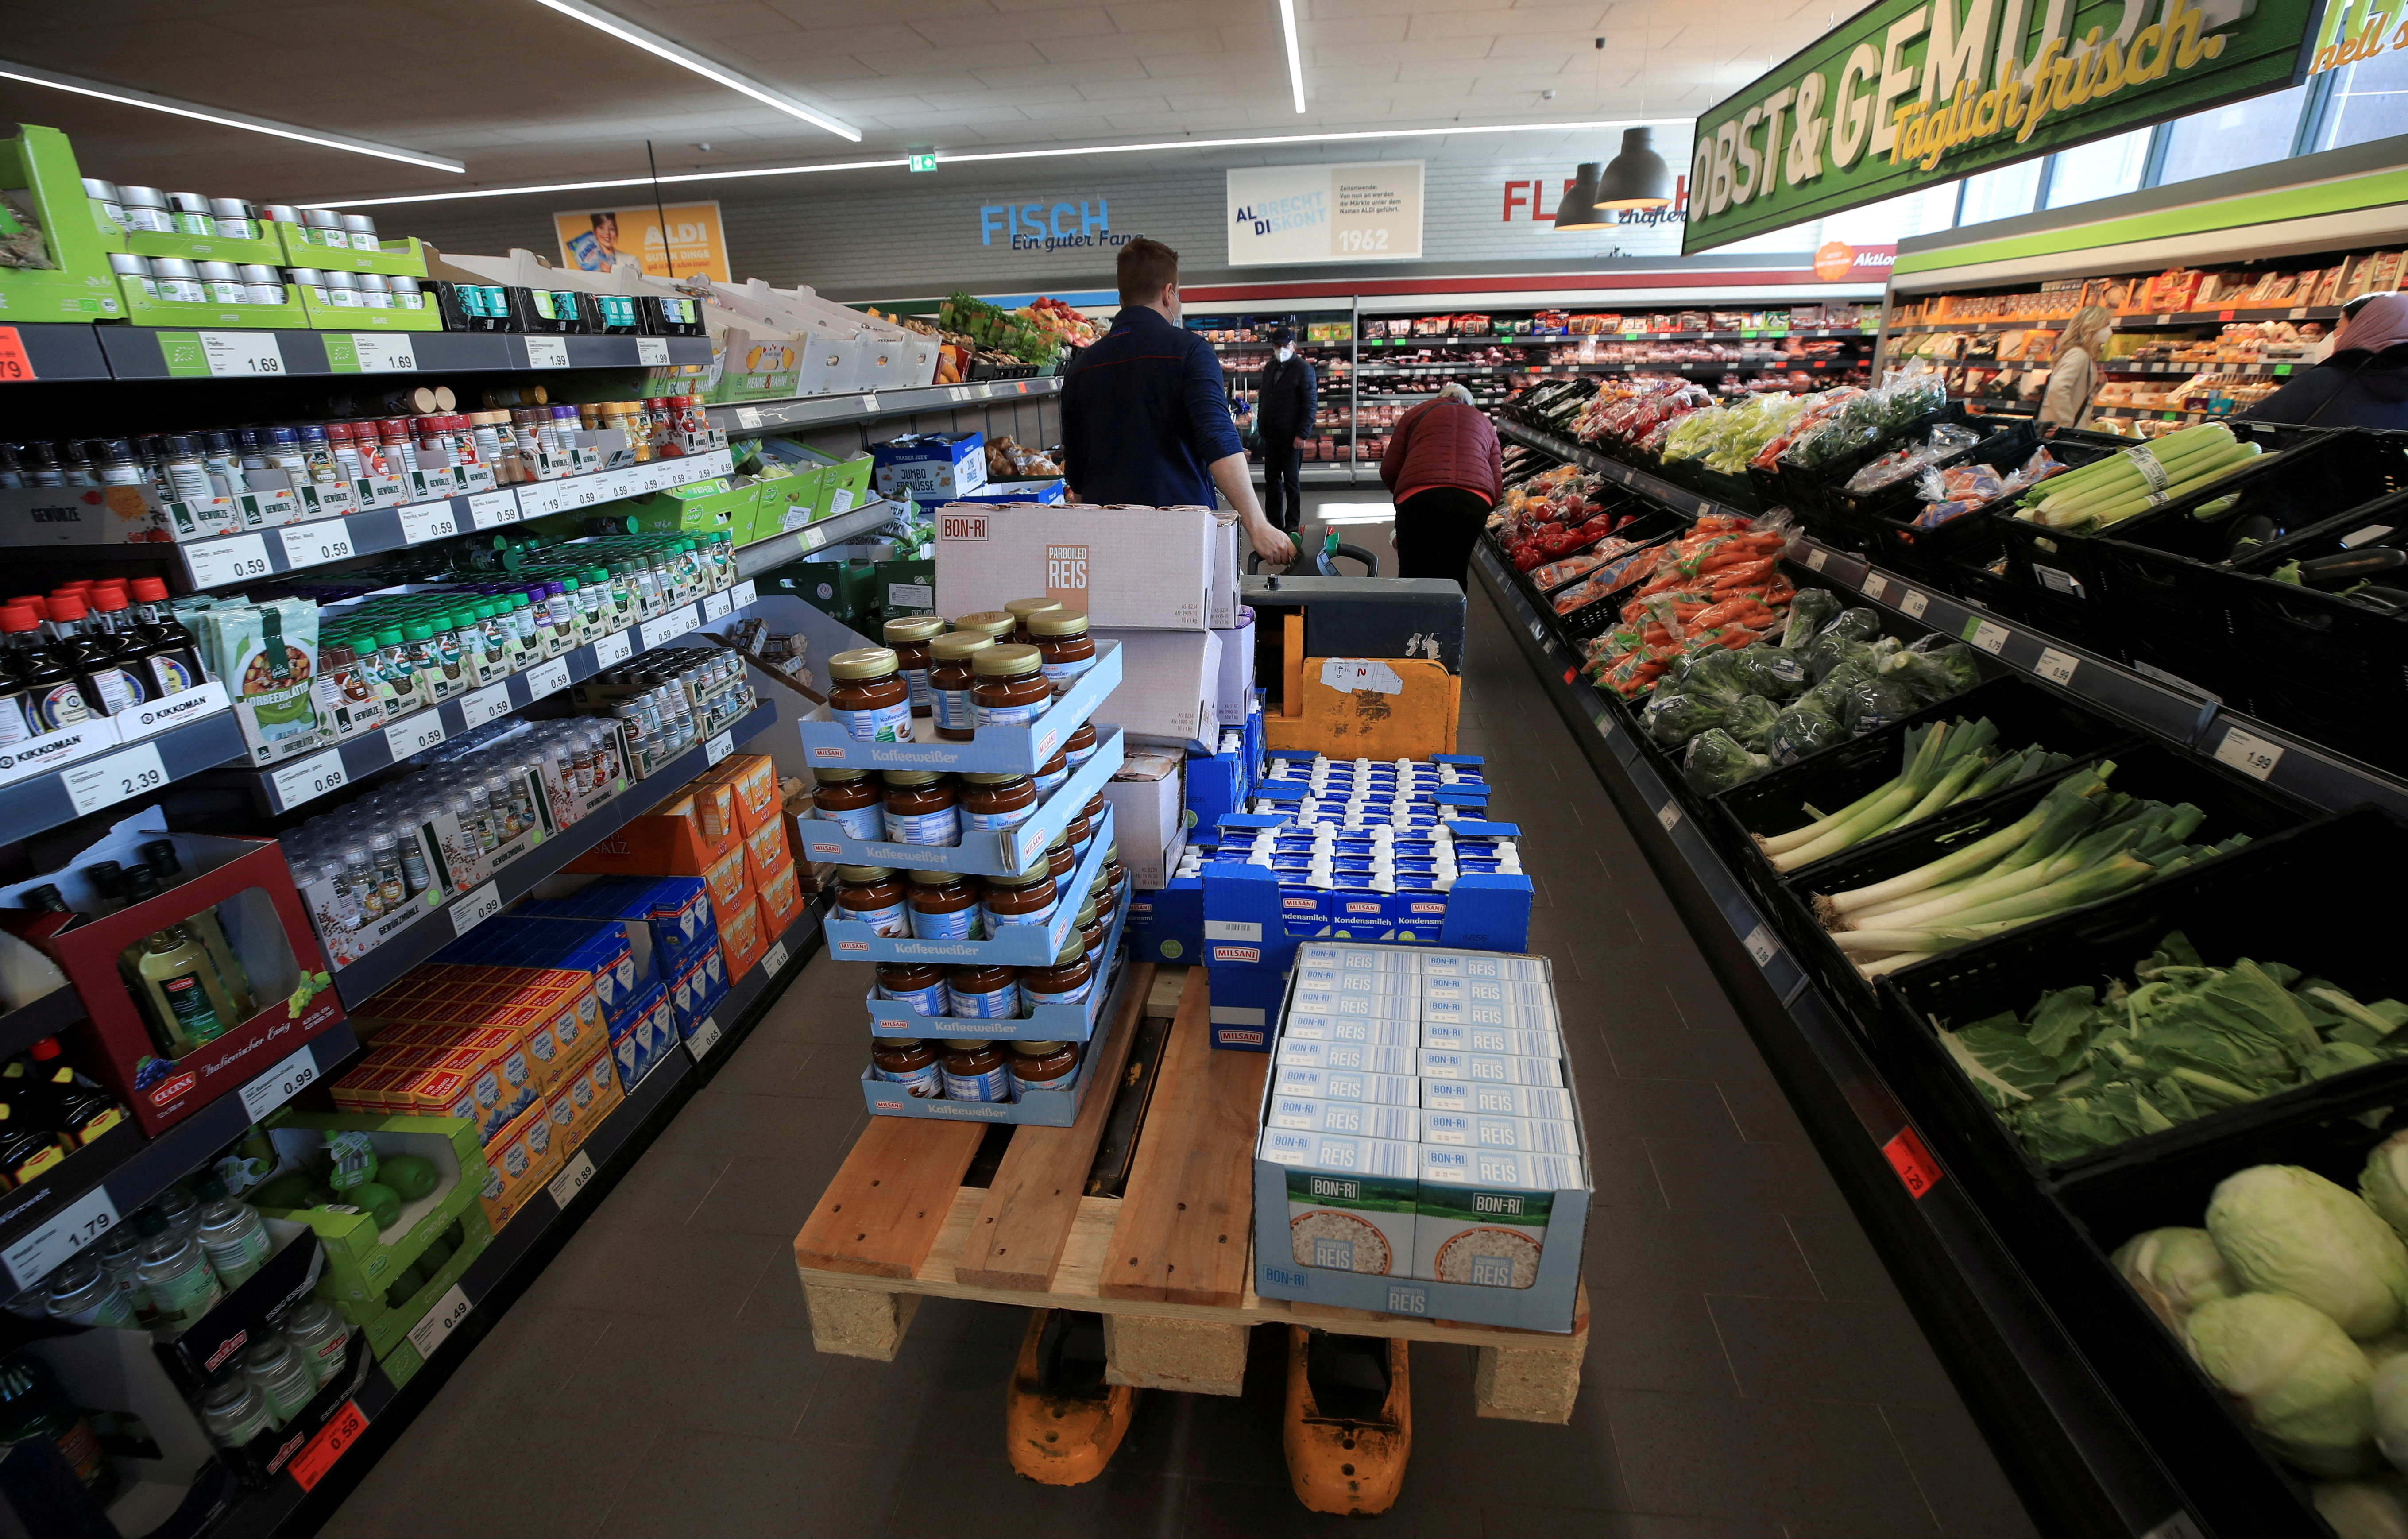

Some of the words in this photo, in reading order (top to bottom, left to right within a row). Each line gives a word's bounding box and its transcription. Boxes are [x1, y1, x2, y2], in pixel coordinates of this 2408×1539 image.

[2308, 12, 2391, 75] nell
[1890, 58, 2028, 170] Täglich
[2016, 0, 2226, 143] frisch.
[1689, 86, 1796, 222] OBST
[1786, 72, 1829, 185] &
[1236, 191, 1323, 223] ALBRECHT
[981, 199, 1109, 245] FISCH
[1254, 208, 1326, 236] DISKONT
[644, 222, 707, 245] ALDI
[1339, 228, 1388, 251] 1962
[1013, 233, 1041, 250] Ein
[1045, 232, 1094, 252] guter
[680, 250, 710, 259] DINGE
[248, 357, 279, 373] 1.69
[389, 356, 412, 369] 1.69
[550, 354, 566, 367] 1.99
[655, 354, 668, 364] 1.99
[688, 379, 696, 394] &
[747, 376, 765, 389] HENNE
[765, 374, 771, 389] &
[770, 375, 787, 387] HAHN!
[551, 459, 568, 468] GEWÜRZE
[583, 454, 597, 463] GEWÜRZE
[699, 469, 710, 479] 0.59
[721, 464, 732, 472] 0.59
[901, 469, 926, 479] JUMBO
[429, 477, 450, 487] GEWÜRZE
[470, 472, 488, 481] GEWÜRZE
[673, 474, 684, 484] 0.59
[377, 485, 399, 495] GEWÜRZE
[614, 486, 628, 497] 0.59
[644, 479, 657, 490] 0.59
[324, 492, 348, 503] GEWÜRZE
[580, 492, 595, 505] 0.59
[265, 501, 291, 514] GEWÜRZE
[542, 499, 559, 512] 1.19
[31, 505, 81, 522] GEWÜRZE
[198, 508, 229, 521] GEWÜRZE
[497, 509, 515, 522] 0.59
[431, 522, 453, 535] 0.59
[945, 519, 985, 537] BON-RI
[322, 542, 348, 558] 0.59
[1049, 547, 1086, 559] PARBOILED
[235, 559, 265, 577] 0.59
[1049, 561, 1086, 589] REIS
[719, 604, 729, 615] 0.59
[686, 619, 697, 629] 0.59
[659, 630, 671, 642] 0.59
[1989, 639, 2001, 650] 1.79
[615, 647, 629, 659] 0.59
[2053, 667, 2070, 680] 0.99
[551, 674, 567, 689] 0.59
[155, 696, 206, 719] KIKKOMAN
[278, 701, 292, 710] GANZ
[489, 701, 508, 716] 0.59
[355, 706, 379, 721] GEWÜRZE
[419, 730, 441, 747] 0.59
[1039, 731, 1056, 756] MILSANI
[17, 735, 81, 762] KIKKOMAN
[721, 744, 731, 756] 0.99
[872, 749, 958, 764] Kaffeeweißer
[2247, 751, 2272, 770] 1.99
[122, 769, 160, 794] 2.39
[315, 771, 342, 792] 0.69
[586, 789, 612, 810] GEWÜRZMÜHLE
[1025, 830, 1044, 858] MILSANI
[492, 842, 525, 867] GEWÜRZMÜHLE
[866, 847, 947, 864] Kaffeeweißer
[479, 899, 497, 918] 0.99
[1286, 899, 1315, 909] MILSANI
[1348, 903, 1379, 913] MILSANI
[1413, 904, 1445, 913] MILSANI
[379, 905, 420, 935] GEWÜRZMÜHLE
[1334, 916, 1392, 926] Kondensmilch
[841, 942, 867, 951] MILSANI
[895, 943, 979, 956] Kaffeeweißer
[1310, 950, 1336, 958] BON-RI
[777, 954, 787, 965] 0.19
[1216, 949, 1258, 961] MILSANI
[1345, 956, 1372, 969] REIS
[1431, 957, 1457, 965] BON-RI
[1469, 964, 1496, 976] REIS
[560, 1015, 571, 1026] Alpen
[935, 1021, 1017, 1034] Kaffeeweißer
[536, 1034, 547, 1046] Alpen
[706, 1029, 718, 1045] 0.65
[1221, 1031, 1261, 1043] MILSANI
[201, 1037, 264, 1077] Italienischer
[267, 1022, 290, 1041] Essig
[284, 1067, 313, 1094] 0.99
[154, 1075, 193, 1102] CUCINA
[1275, 1136, 1308, 1148] BON-RI
[1320, 1147, 1355, 1168] REIS
[1431, 1152, 1465, 1164] BON-RI
[575, 1167, 592, 1187] 0.89
[1480, 1164, 1518, 1183] REIS
[1314, 1179, 1356, 1199] BON-RI
[1476, 1197, 1520, 1214] BON-RI
[68, 1213, 110, 1246] 1.79
[1317, 1248, 1349, 1269] REIS
[1266, 1268, 1305, 1286] BON-RI
[1473, 1266, 1509, 1285] REIS
[1389, 1294, 1425, 1313] REIS
[444, 1303, 467, 1328] 0.49
[331, 1419, 359, 1450] 0.59
